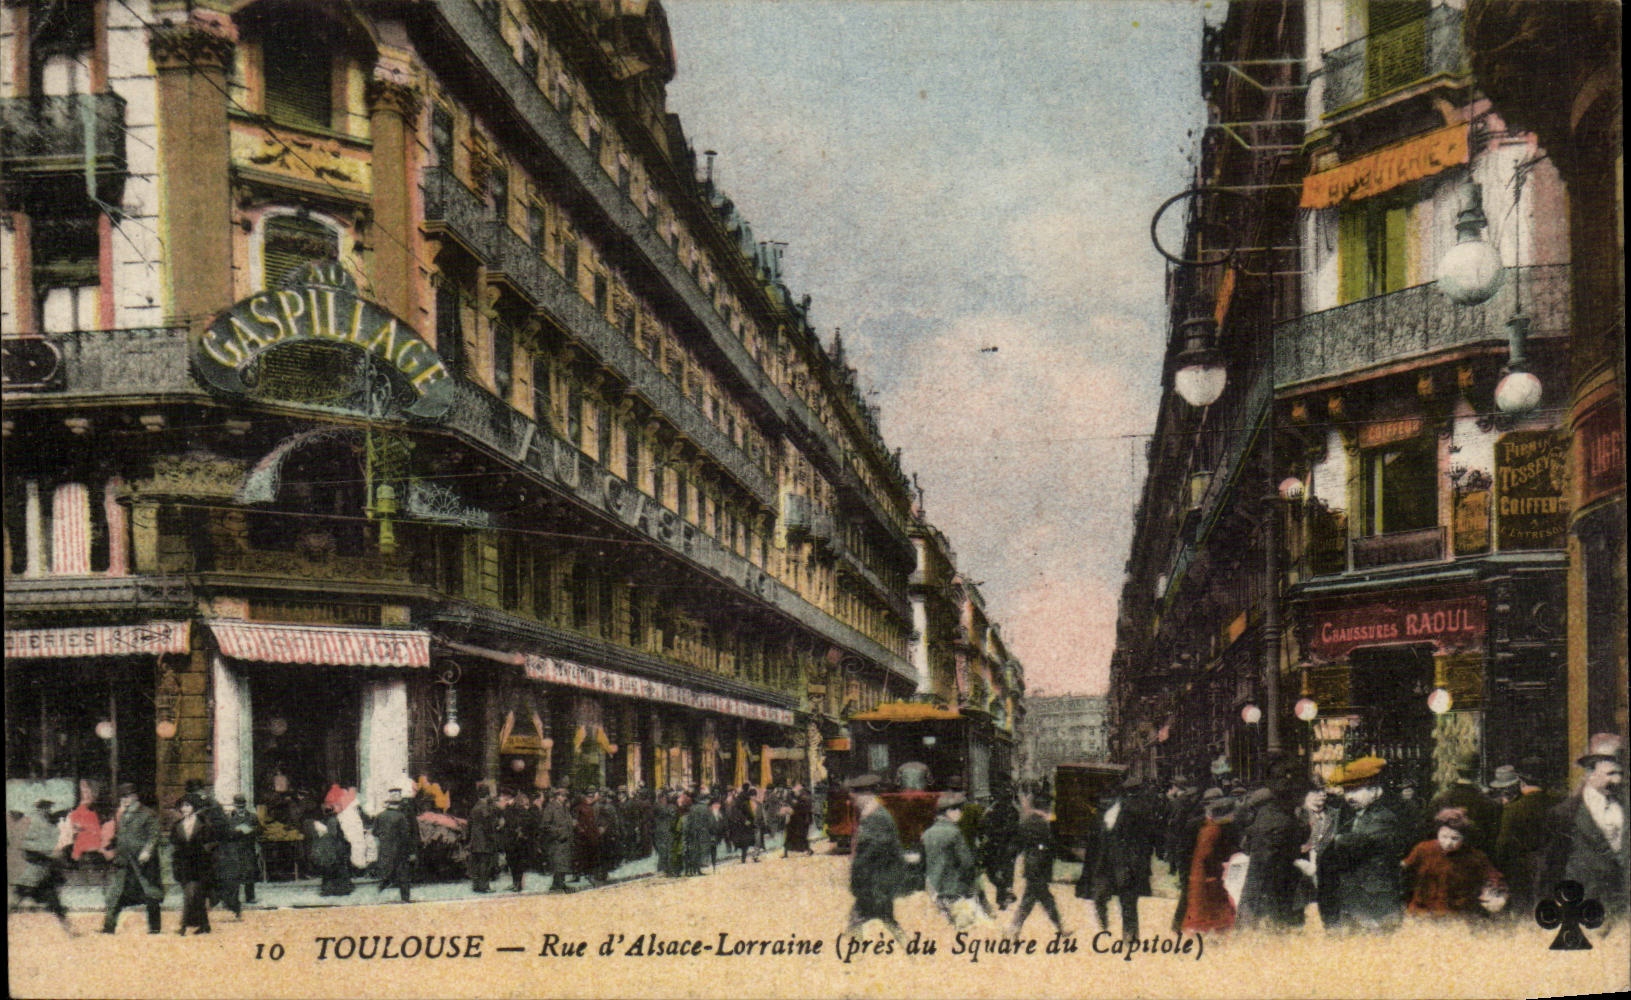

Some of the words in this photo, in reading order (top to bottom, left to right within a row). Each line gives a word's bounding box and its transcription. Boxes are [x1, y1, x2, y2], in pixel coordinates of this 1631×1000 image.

[203, 289, 449, 396] GASPILLAGE
[1321, 622, 1399, 643] CHAUSSURES
[1406, 609, 1475, 636] RAOUL
